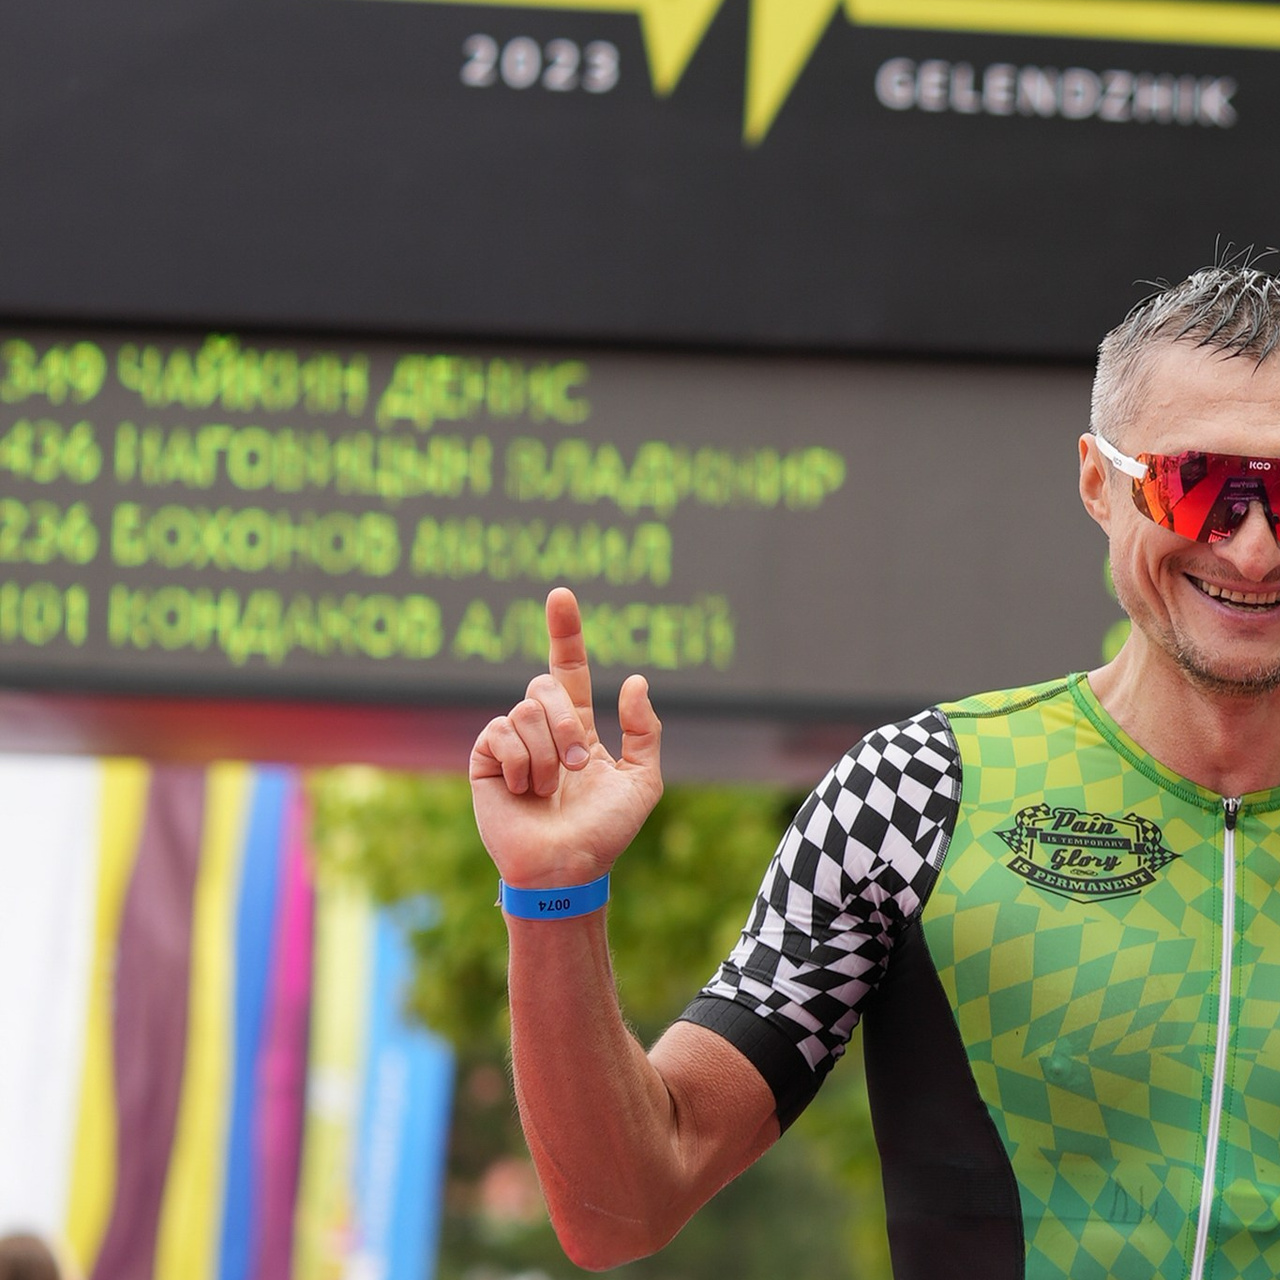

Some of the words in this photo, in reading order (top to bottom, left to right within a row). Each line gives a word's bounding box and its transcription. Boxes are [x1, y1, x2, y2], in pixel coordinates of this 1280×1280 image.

[460, 33, 621, 94] 2023
[874, 57, 1238, 128] GELENDZHIK
[0, 339, 107, 404] 349
[1051, 810, 1117, 834] Pain
[1061, 837, 1125, 848] TEMPORARY
[1050, 849, 1121, 870] Glory
[1012, 859, 1031, 874] IS
[1034, 872, 1147, 892] PERMANENT
[538, 898, 571, 911] 0074
